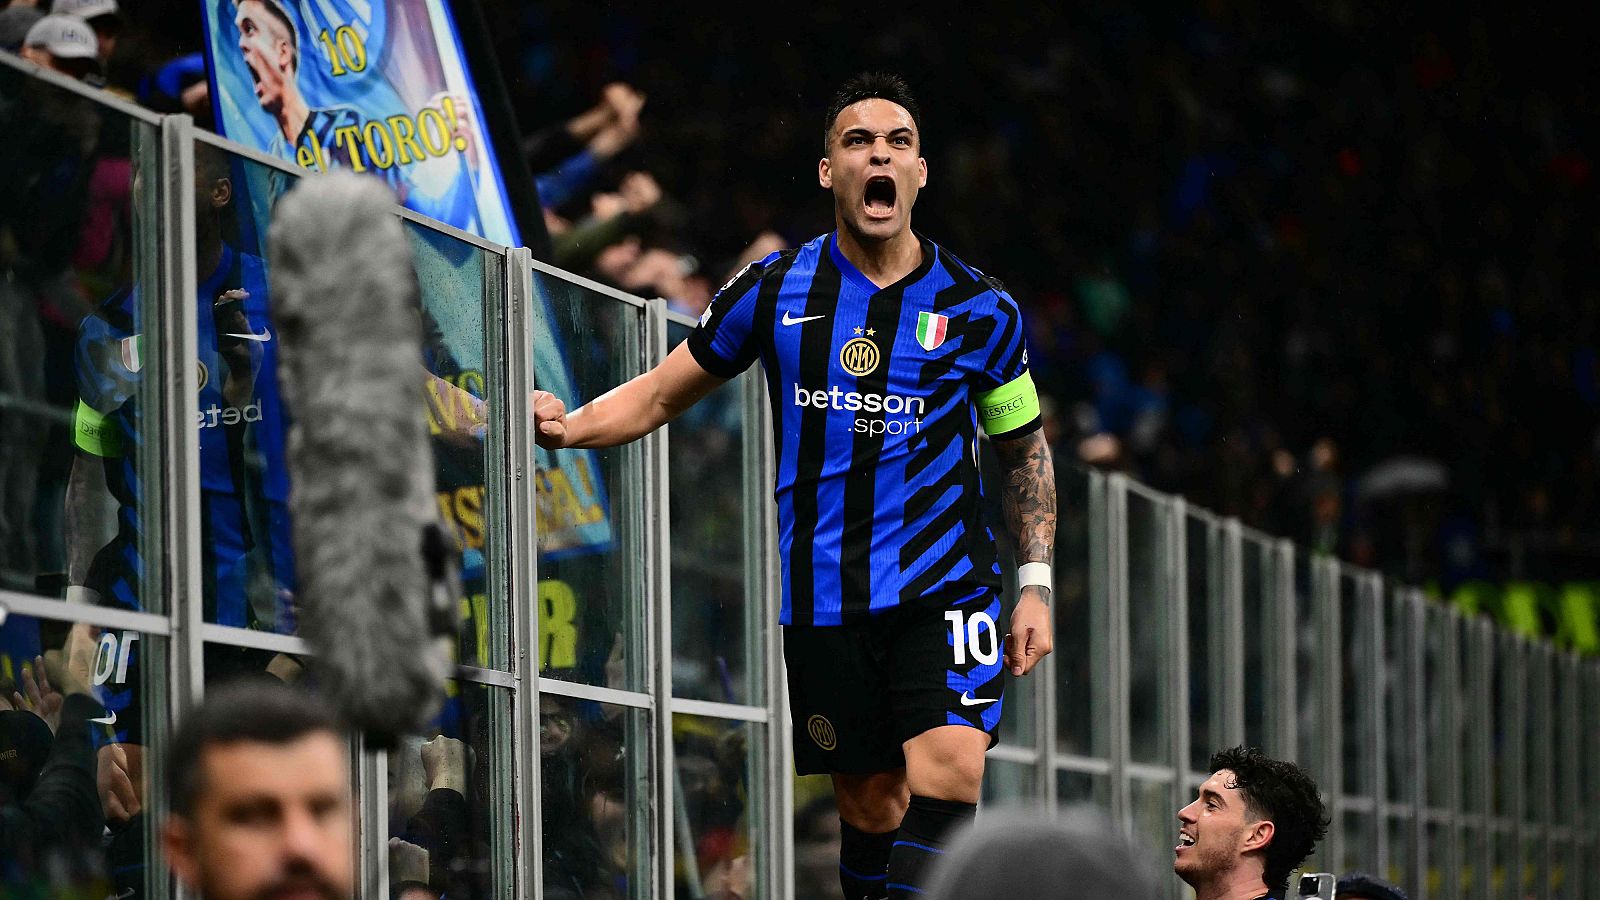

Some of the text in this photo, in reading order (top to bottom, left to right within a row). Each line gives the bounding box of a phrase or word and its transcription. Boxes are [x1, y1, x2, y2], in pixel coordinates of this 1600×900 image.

[319, 25, 367, 76] 10
[335, 96, 467, 173] TORO!
[794, 382, 925, 415] betsson
[983, 396, 1025, 418] RESPECT
[847, 417, 924, 437] .sport
[944, 610, 999, 666] 10
